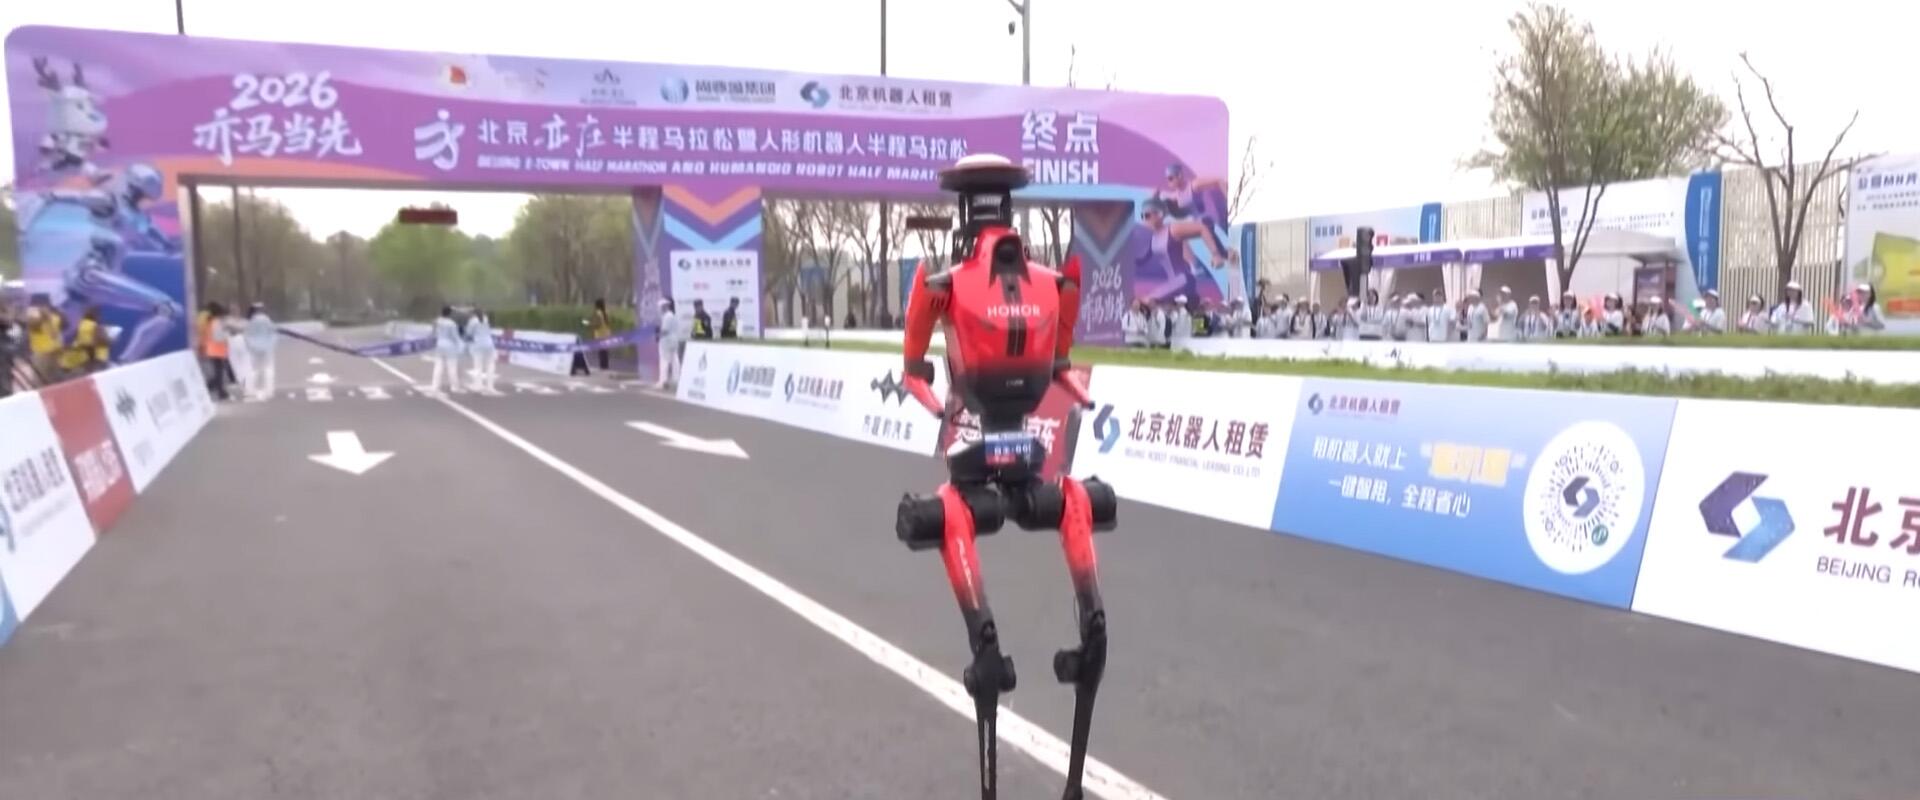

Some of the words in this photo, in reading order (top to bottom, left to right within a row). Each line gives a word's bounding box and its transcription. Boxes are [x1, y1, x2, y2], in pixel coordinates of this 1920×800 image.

[230, 71, 338, 110] 2026
[193, 108, 363, 167] 亦马当先
[1021, 110, 1099, 153] 终点
[607, 160, 667, 174] MARATHON
[796, 162, 843, 177] ROBOT
[847, 165, 882, 178] HALF
[886, 166, 939, 181] MARAT
[1022, 158, 1099, 185] FINISH
[1091, 263, 1122, 294] 2026
[987, 304, 1040, 318] HONOR
[1128, 410, 1269, 459] 北京机器人租赁
[1817, 556, 1891, 584] BEIJING
[1903, 569, 1920, 590] R
